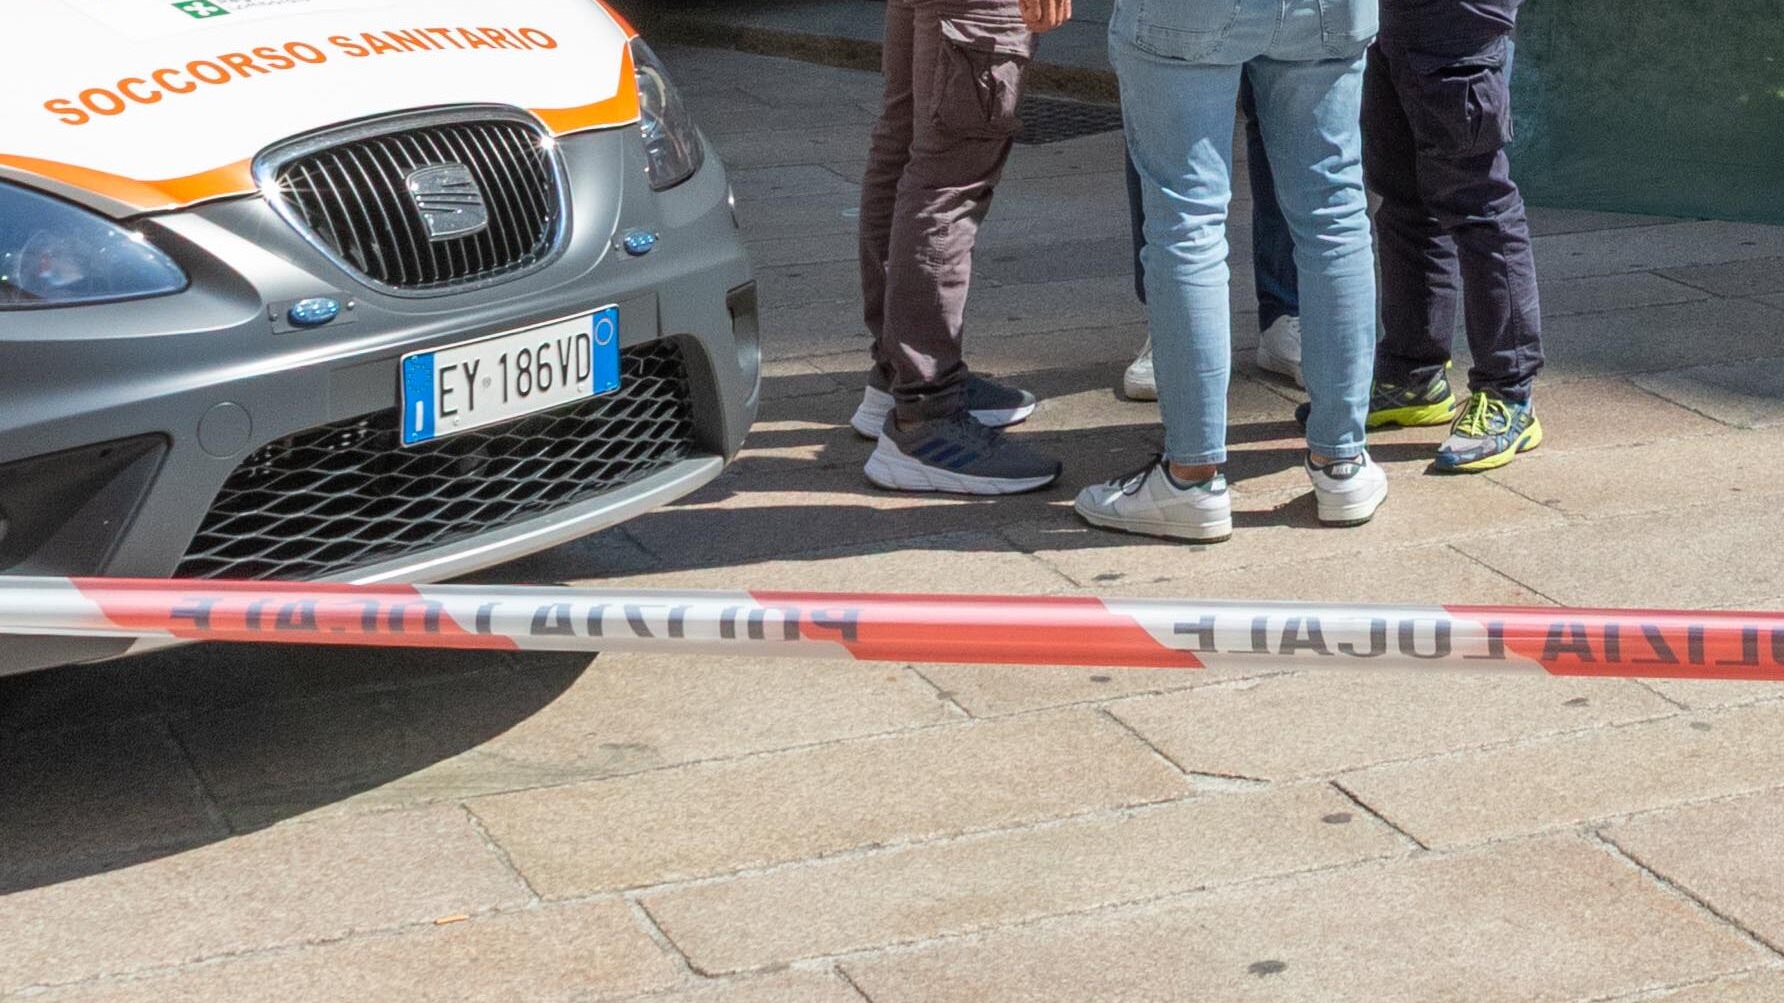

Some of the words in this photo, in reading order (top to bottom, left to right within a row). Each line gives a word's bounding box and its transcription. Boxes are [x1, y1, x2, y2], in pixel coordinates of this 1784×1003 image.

[43, 41, 328, 126] SOCCORSO
[328, 26, 558, 57] SANITARIO
[439, 358, 480, 418] EY
[499, 332, 591, 404] 186VD
